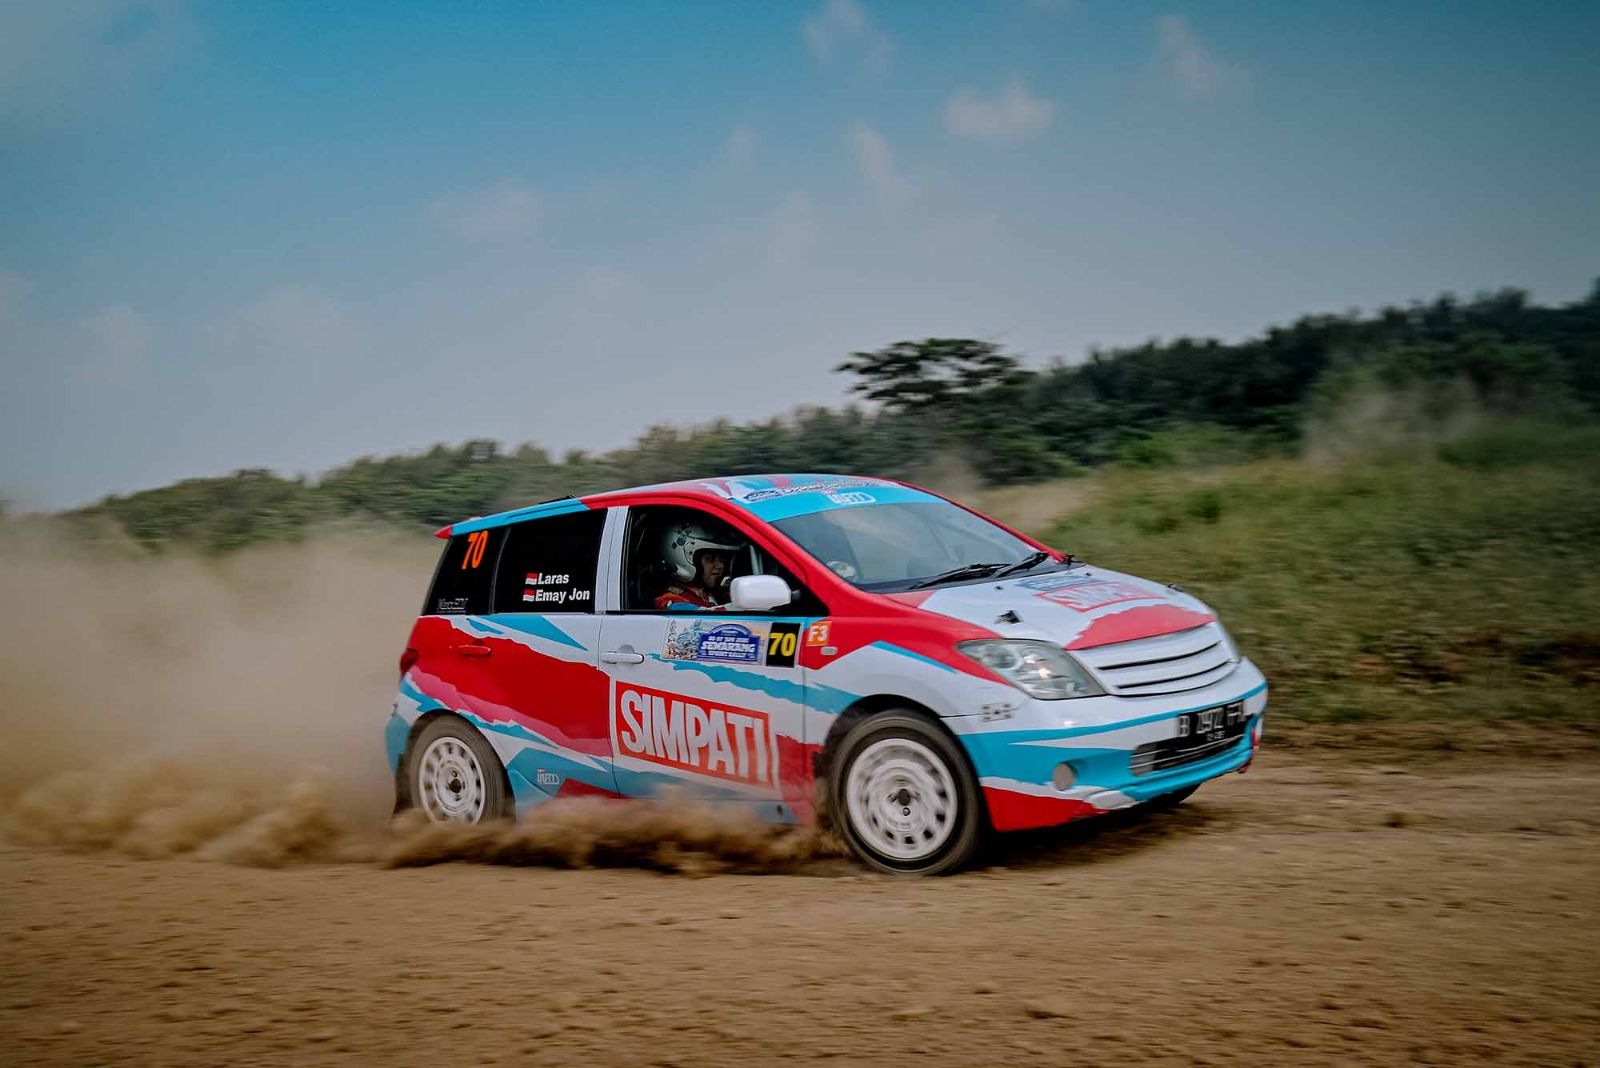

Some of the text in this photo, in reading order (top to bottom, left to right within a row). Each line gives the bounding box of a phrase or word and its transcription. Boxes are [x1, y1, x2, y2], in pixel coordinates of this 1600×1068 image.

[461, 530, 489, 569] 70
[537, 573, 569, 585] Laras
[535, 588, 590, 604] Emay Jon
[808, 625, 829, 641] F3
[701, 641, 756, 653] SEMARANG
[769, 633, 797, 657] 70
[621, 689, 769, 783] SIMPATI
